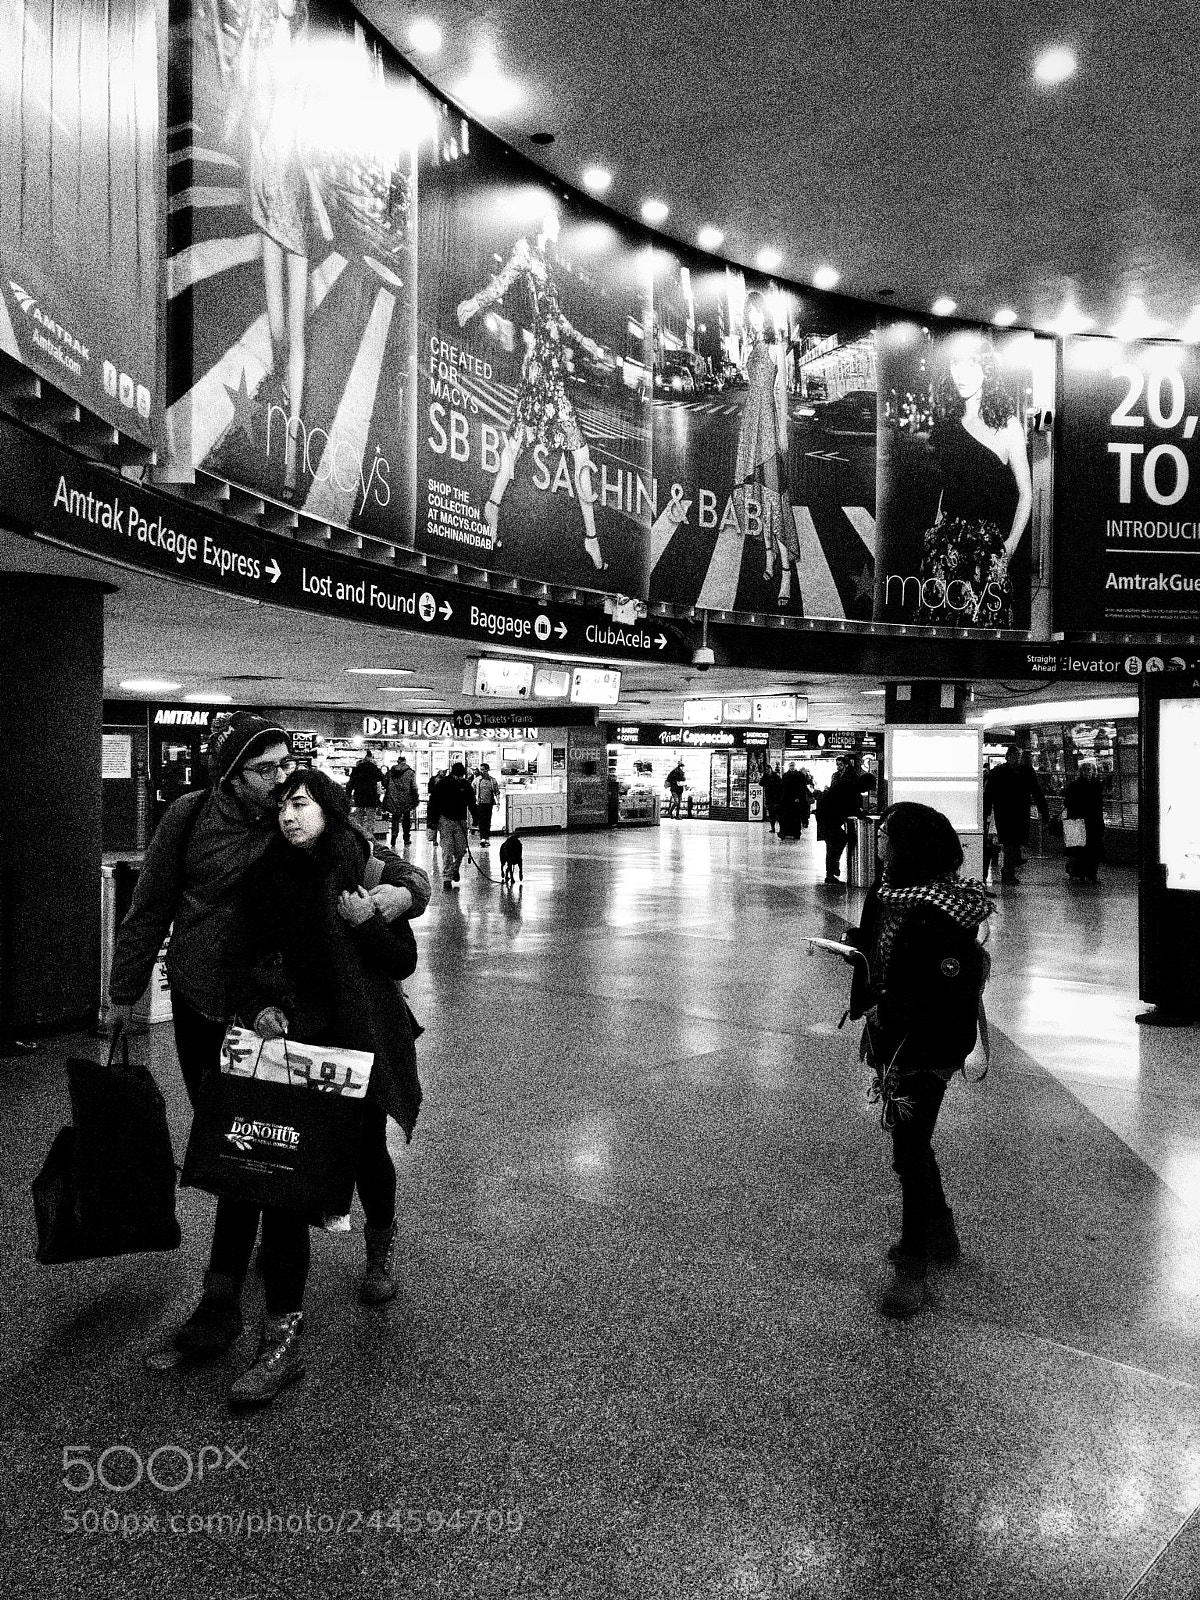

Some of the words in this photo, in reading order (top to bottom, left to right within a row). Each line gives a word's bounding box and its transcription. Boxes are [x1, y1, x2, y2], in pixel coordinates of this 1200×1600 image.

[33, 308, 90, 361] AMTRAK
[32, 327, 81, 376] Amtrak.com
[430, 336, 492, 380] CREATED
[430, 356, 458, 385] FOR
[430, 376, 479, 414] MACYS
[428, 402, 470, 462] SB
[532, 443, 658, 518] SACHIN
[666, 483, 690, 524] &
[1107, 442, 1190, 506] TO
[428, 478, 452, 496] SHOP
[453, 487, 470, 504] THE
[427, 507, 439, 521] AT
[428, 493, 480, 520] COLLECTION
[53, 475, 124, 534] Amtrak
[127, 506, 198, 564] Package
[202, 536, 261, 579] Express
[427, 521, 494, 551] SACHINANDBABI
[1106, 520, 1200, 540] INTRODUCI
[302, 567, 333, 599] Lost
[335, 579, 365, 607] and
[369, 585, 416, 615] Found
[470, 605, 531, 636] Baggage
[585, 624, 651, 650] ClubAcela
[1026, 654, 1057, 665] Straight
[1031, 663, 1058, 672] Ahead
[154, 709, 210, 726] AMTRAK
[483, 714, 507, 724] Tickets
[511, 713, 533, 724] Trains
[231, 1121, 300, 1144] DONOHUE
